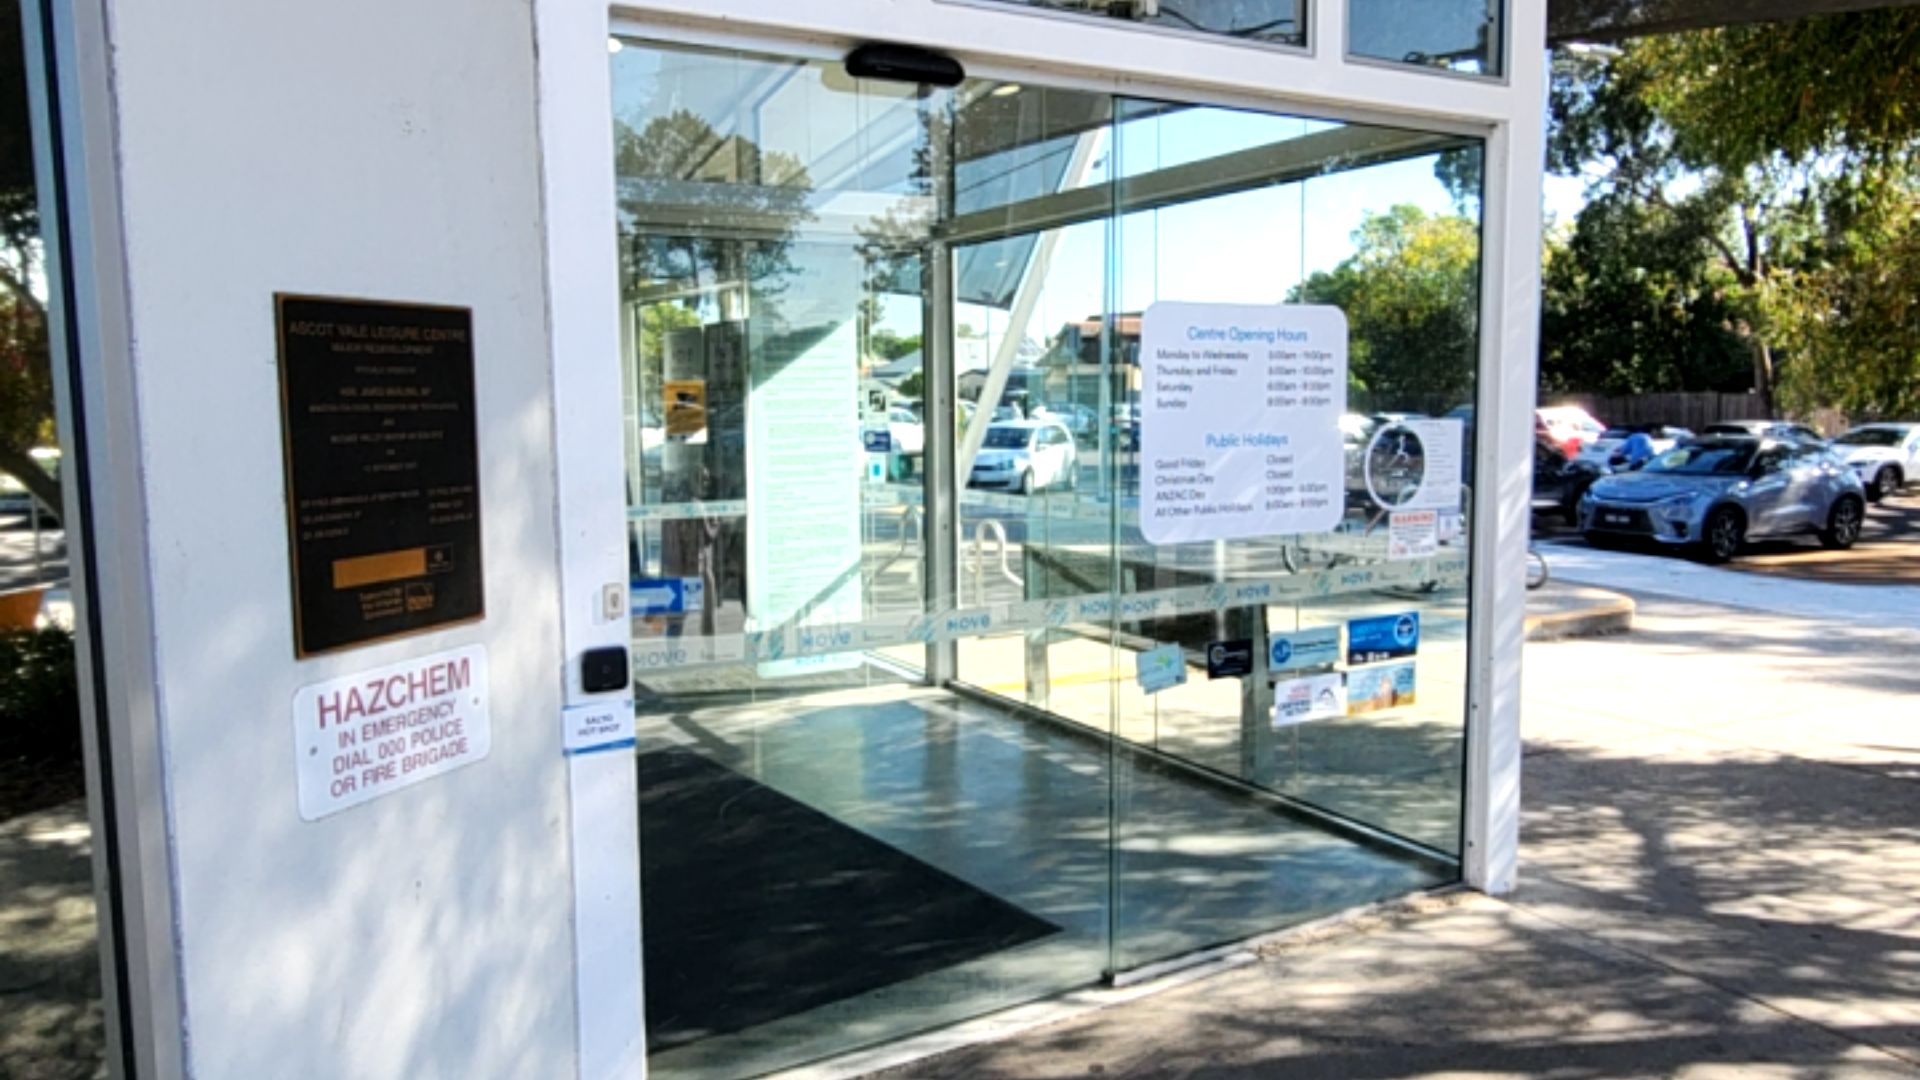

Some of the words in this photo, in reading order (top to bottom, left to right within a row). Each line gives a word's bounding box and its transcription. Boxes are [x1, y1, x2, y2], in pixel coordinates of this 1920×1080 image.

[337, 323, 369, 338] VALE
[422, 328, 466, 343] CENTRE
[1187, 326, 1226, 341] Centre
[1229, 326, 1275, 344] Opening
[1277, 328, 1308, 341] Hours
[1156, 349, 1190, 361] Monday
[1192, 350, 1201, 360] to
[1203, 349, 1249, 362] Wednesday
[1156, 365, 1194, 377] Thursday
[1196, 366, 1211, 376] and
[1213, 366, 1238, 377] Friday
[1156, 382, 1194, 393] Saturday
[1156, 398, 1188, 410] Sunday
[1205, 433, 1240, 448] Public
[1243, 433, 1289, 448] Holidays
[1155, 459, 1179, 470] Good
[1181, 457, 1206, 469] Friday
[1266, 454, 1294, 465] Closed
[1155, 474, 1198, 486] Christmas
[1199, 472, 1214, 485] Day
[1266, 470, 1293, 480] Closed
[1155, 490, 1189, 502] ANZAC
[1189, 489, 1206, 501] Day
[1155, 507, 1167, 518] All
[1168, 505, 1191, 517] Other
[1194, 504, 1216, 516] Public
[317, 657, 471, 730] HAZCHEM
[338, 728, 356, 749] IN
[362, 698, 457, 742] EMERGENCY
[333, 748, 373, 775] DIAL
[378, 737, 406, 759] 000
[411, 718, 464, 747] POLICE
[330, 777, 357, 798] OR
[362, 761, 397, 788] FIRE
[402, 737, 469, 774] BRIGADE
